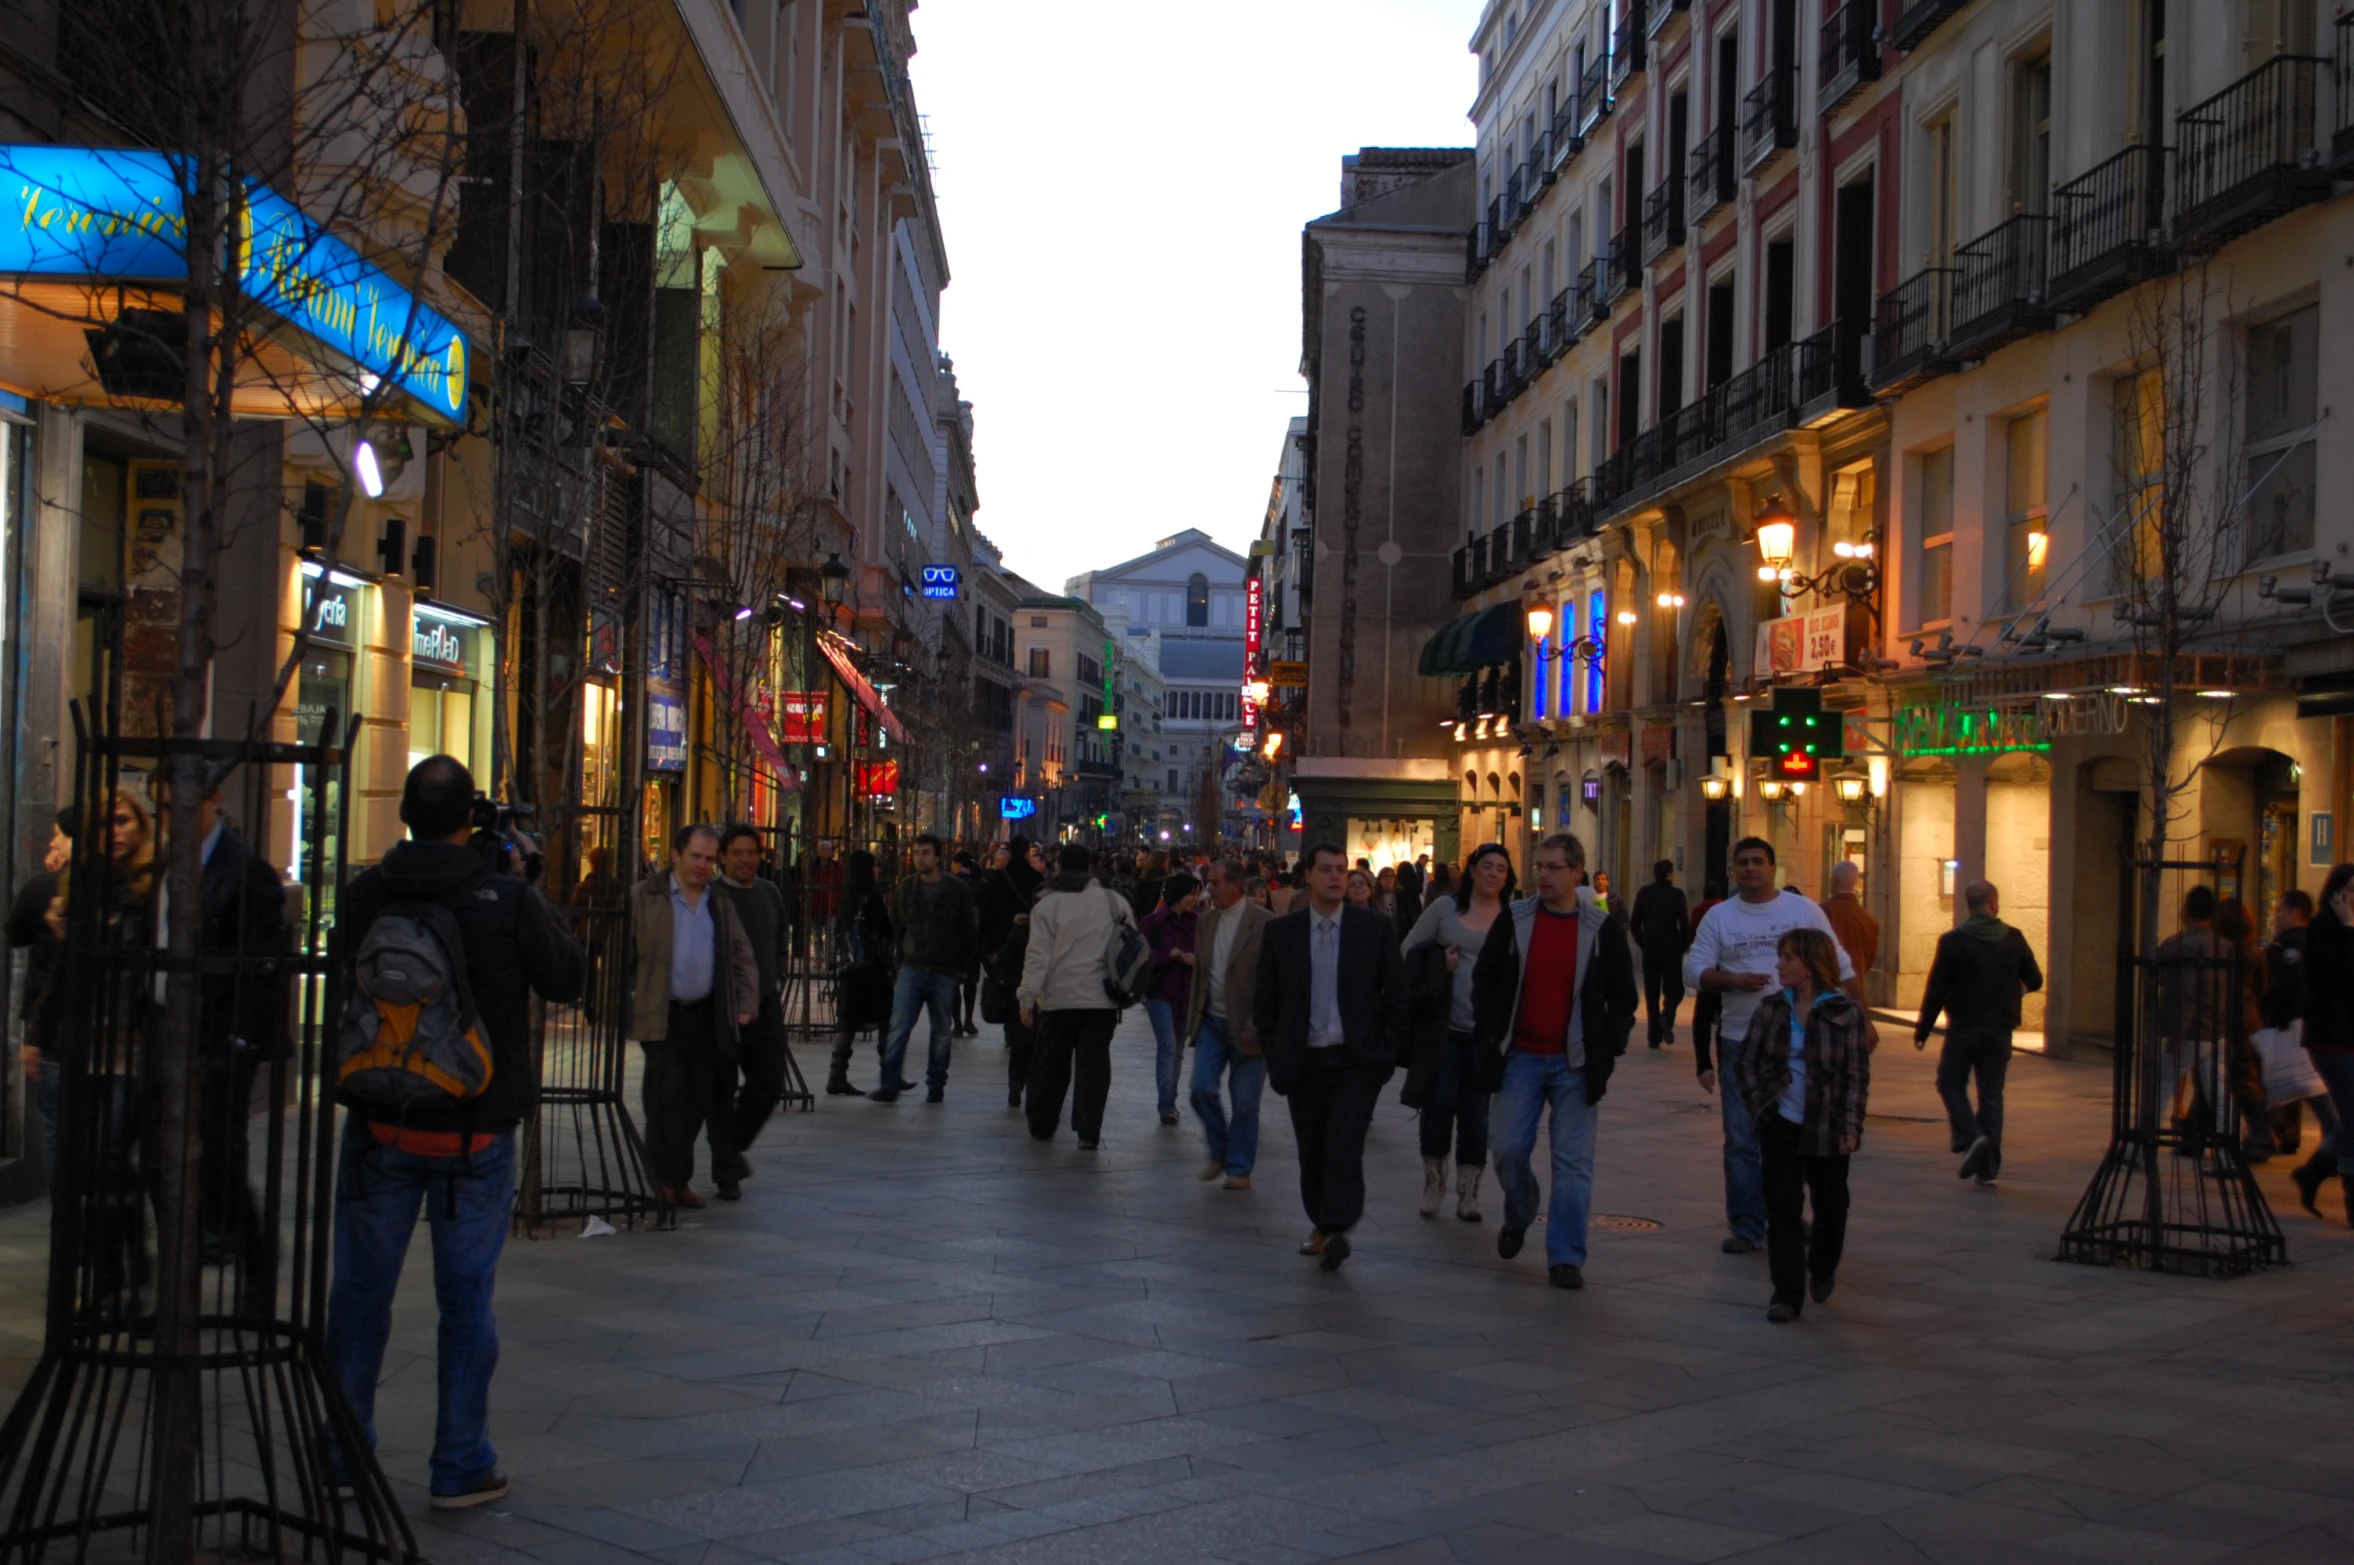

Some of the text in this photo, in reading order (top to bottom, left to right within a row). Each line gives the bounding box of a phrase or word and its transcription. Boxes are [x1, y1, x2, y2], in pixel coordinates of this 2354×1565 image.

[922, 586, 955, 598] OPTICA
[1248, 580, 1260, 642] PETIT
[1810, 634, 1836, 660] 2,50€
[1245, 651, 1257, 726] PACE
[2315, 818, 2328, 846] H
